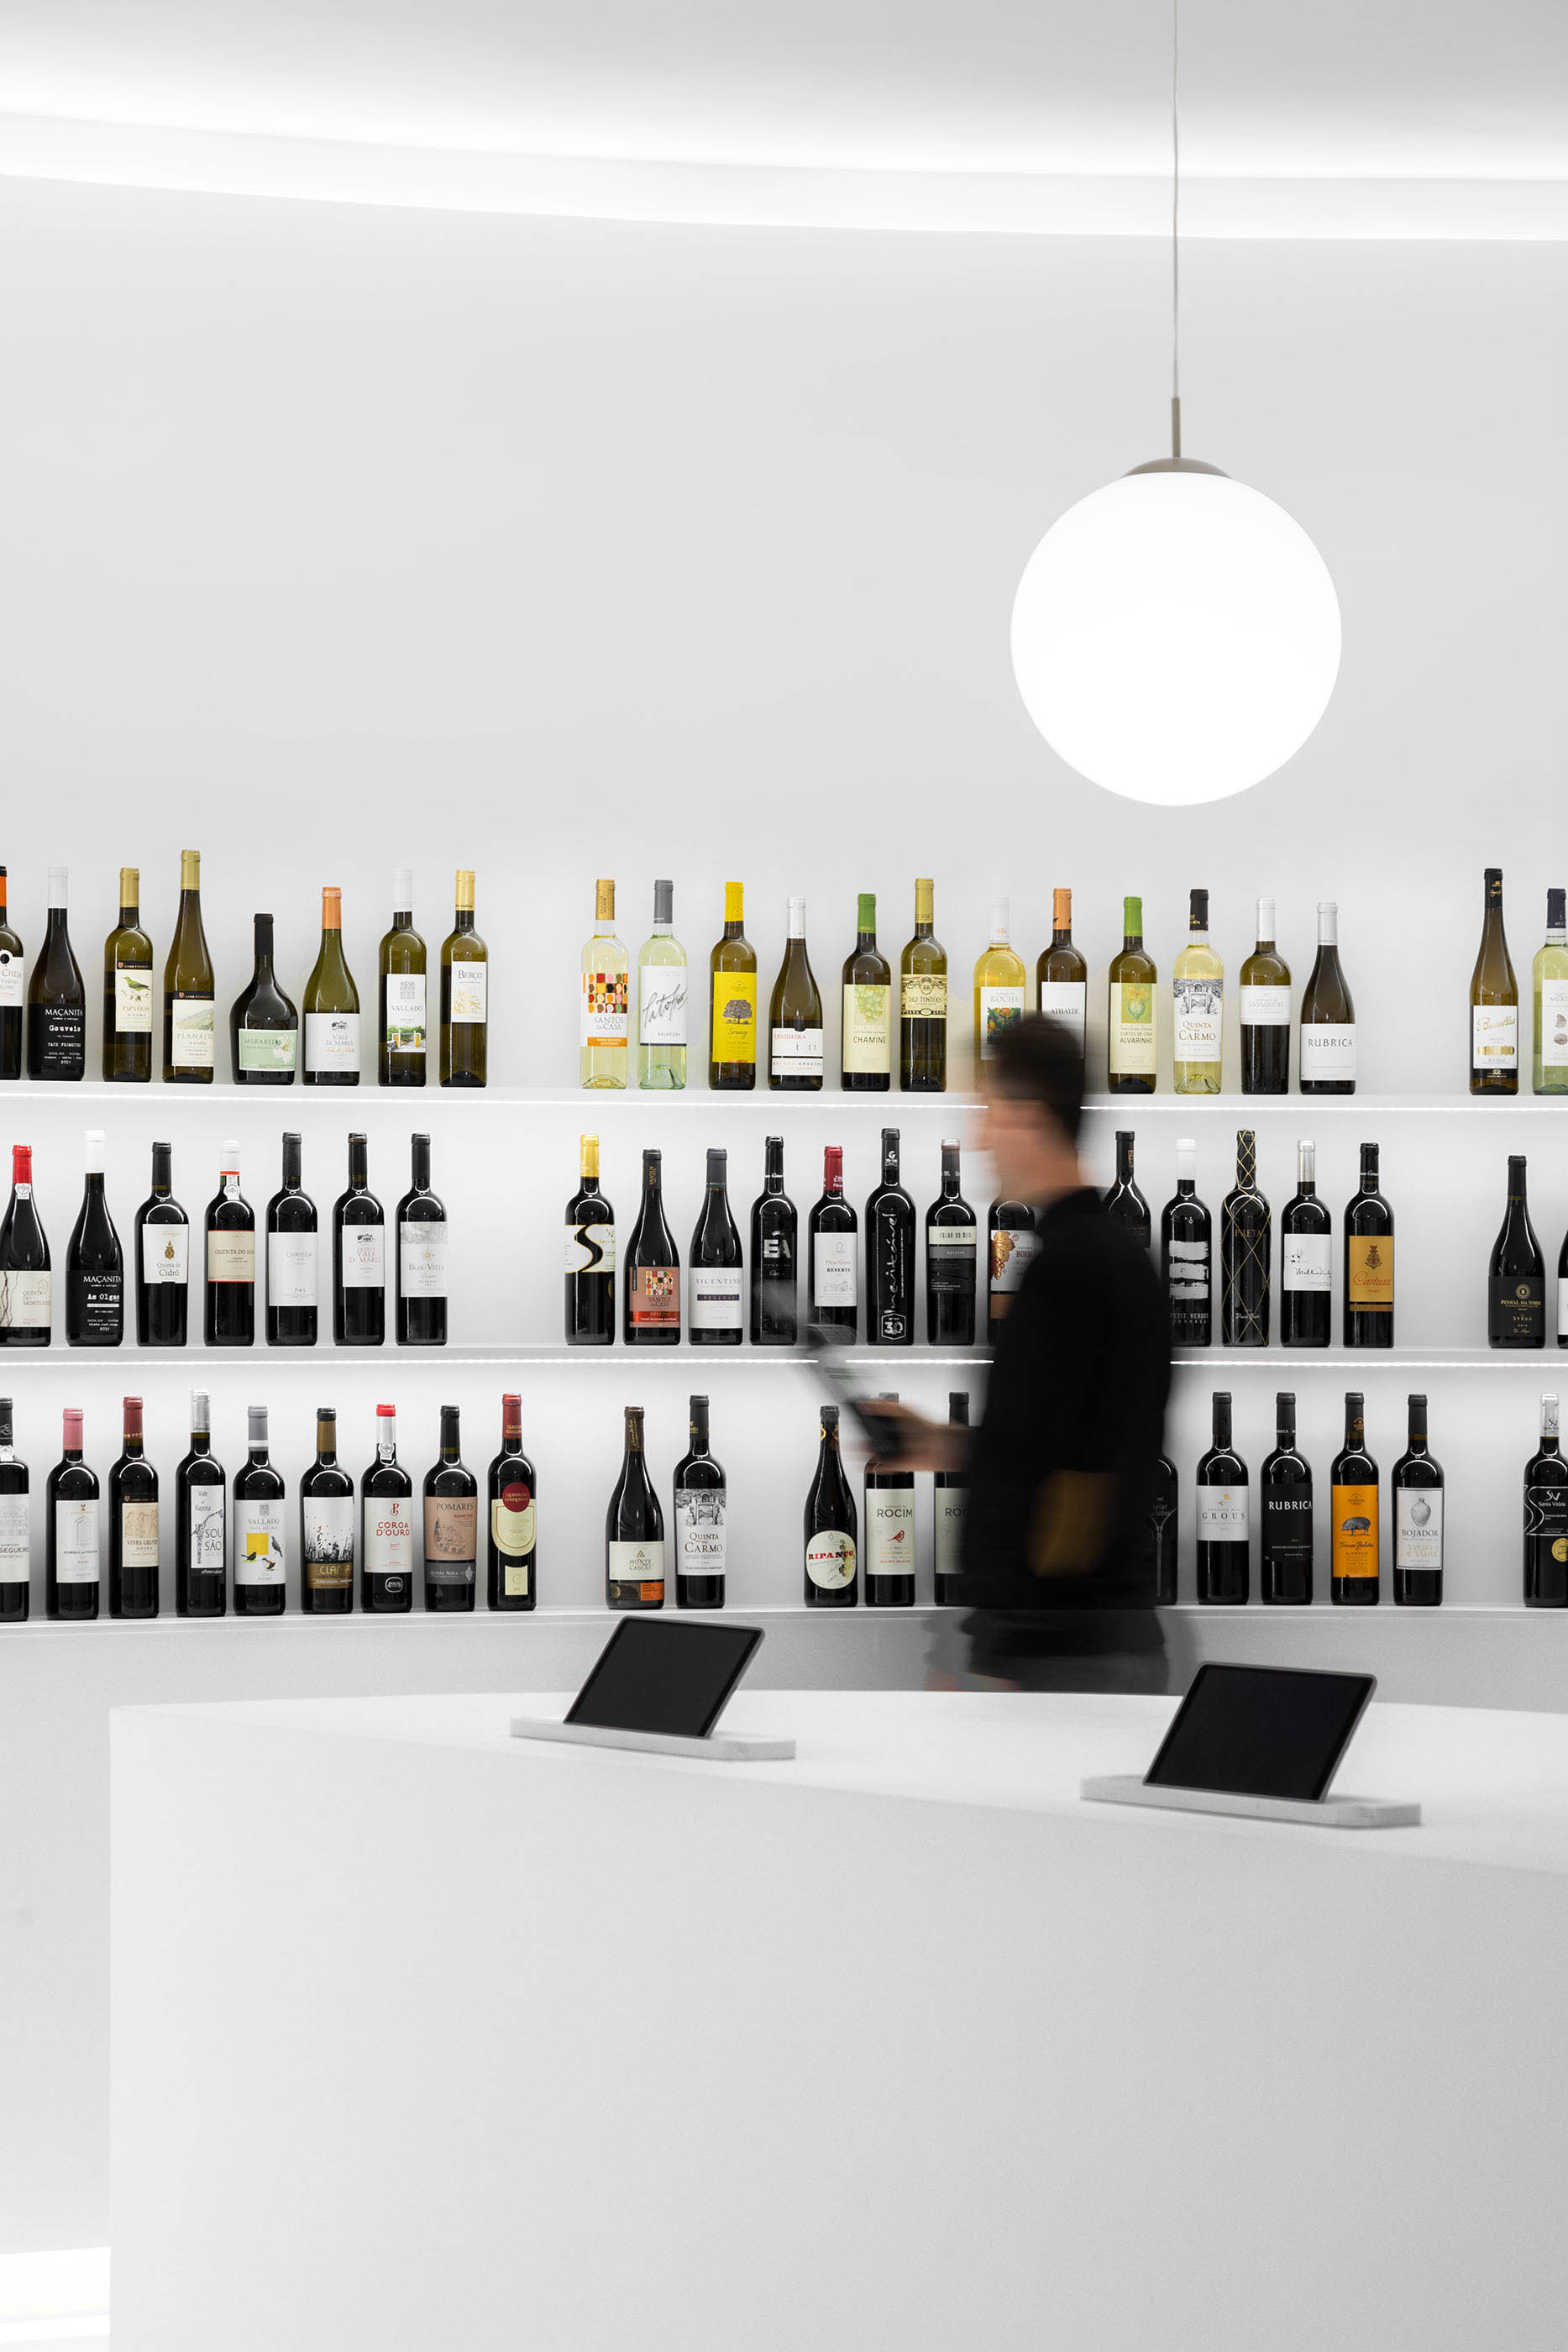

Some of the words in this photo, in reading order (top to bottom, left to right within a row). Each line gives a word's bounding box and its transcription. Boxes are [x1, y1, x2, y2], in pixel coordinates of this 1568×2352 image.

[1183, 1021, 1212, 1030] QUINTA
[1178, 1030, 1216, 1041] CARMO
[1308, 1038, 1354, 1047] RUBRICA
[436, 1503, 474, 1511] POMARES
[1268, 1500, 1312, 1510] RUBRICA
[877, 1509, 913, 1518] ROCIM
[205, 1528, 223, 1539] SOU
[689, 1531, 720, 1541] QUINTA
[1402, 1529, 1439, 1538] BOJADOR
[205, 1539, 222, 1551] SÃO
[684, 1542, 723, 1553] CARMO
